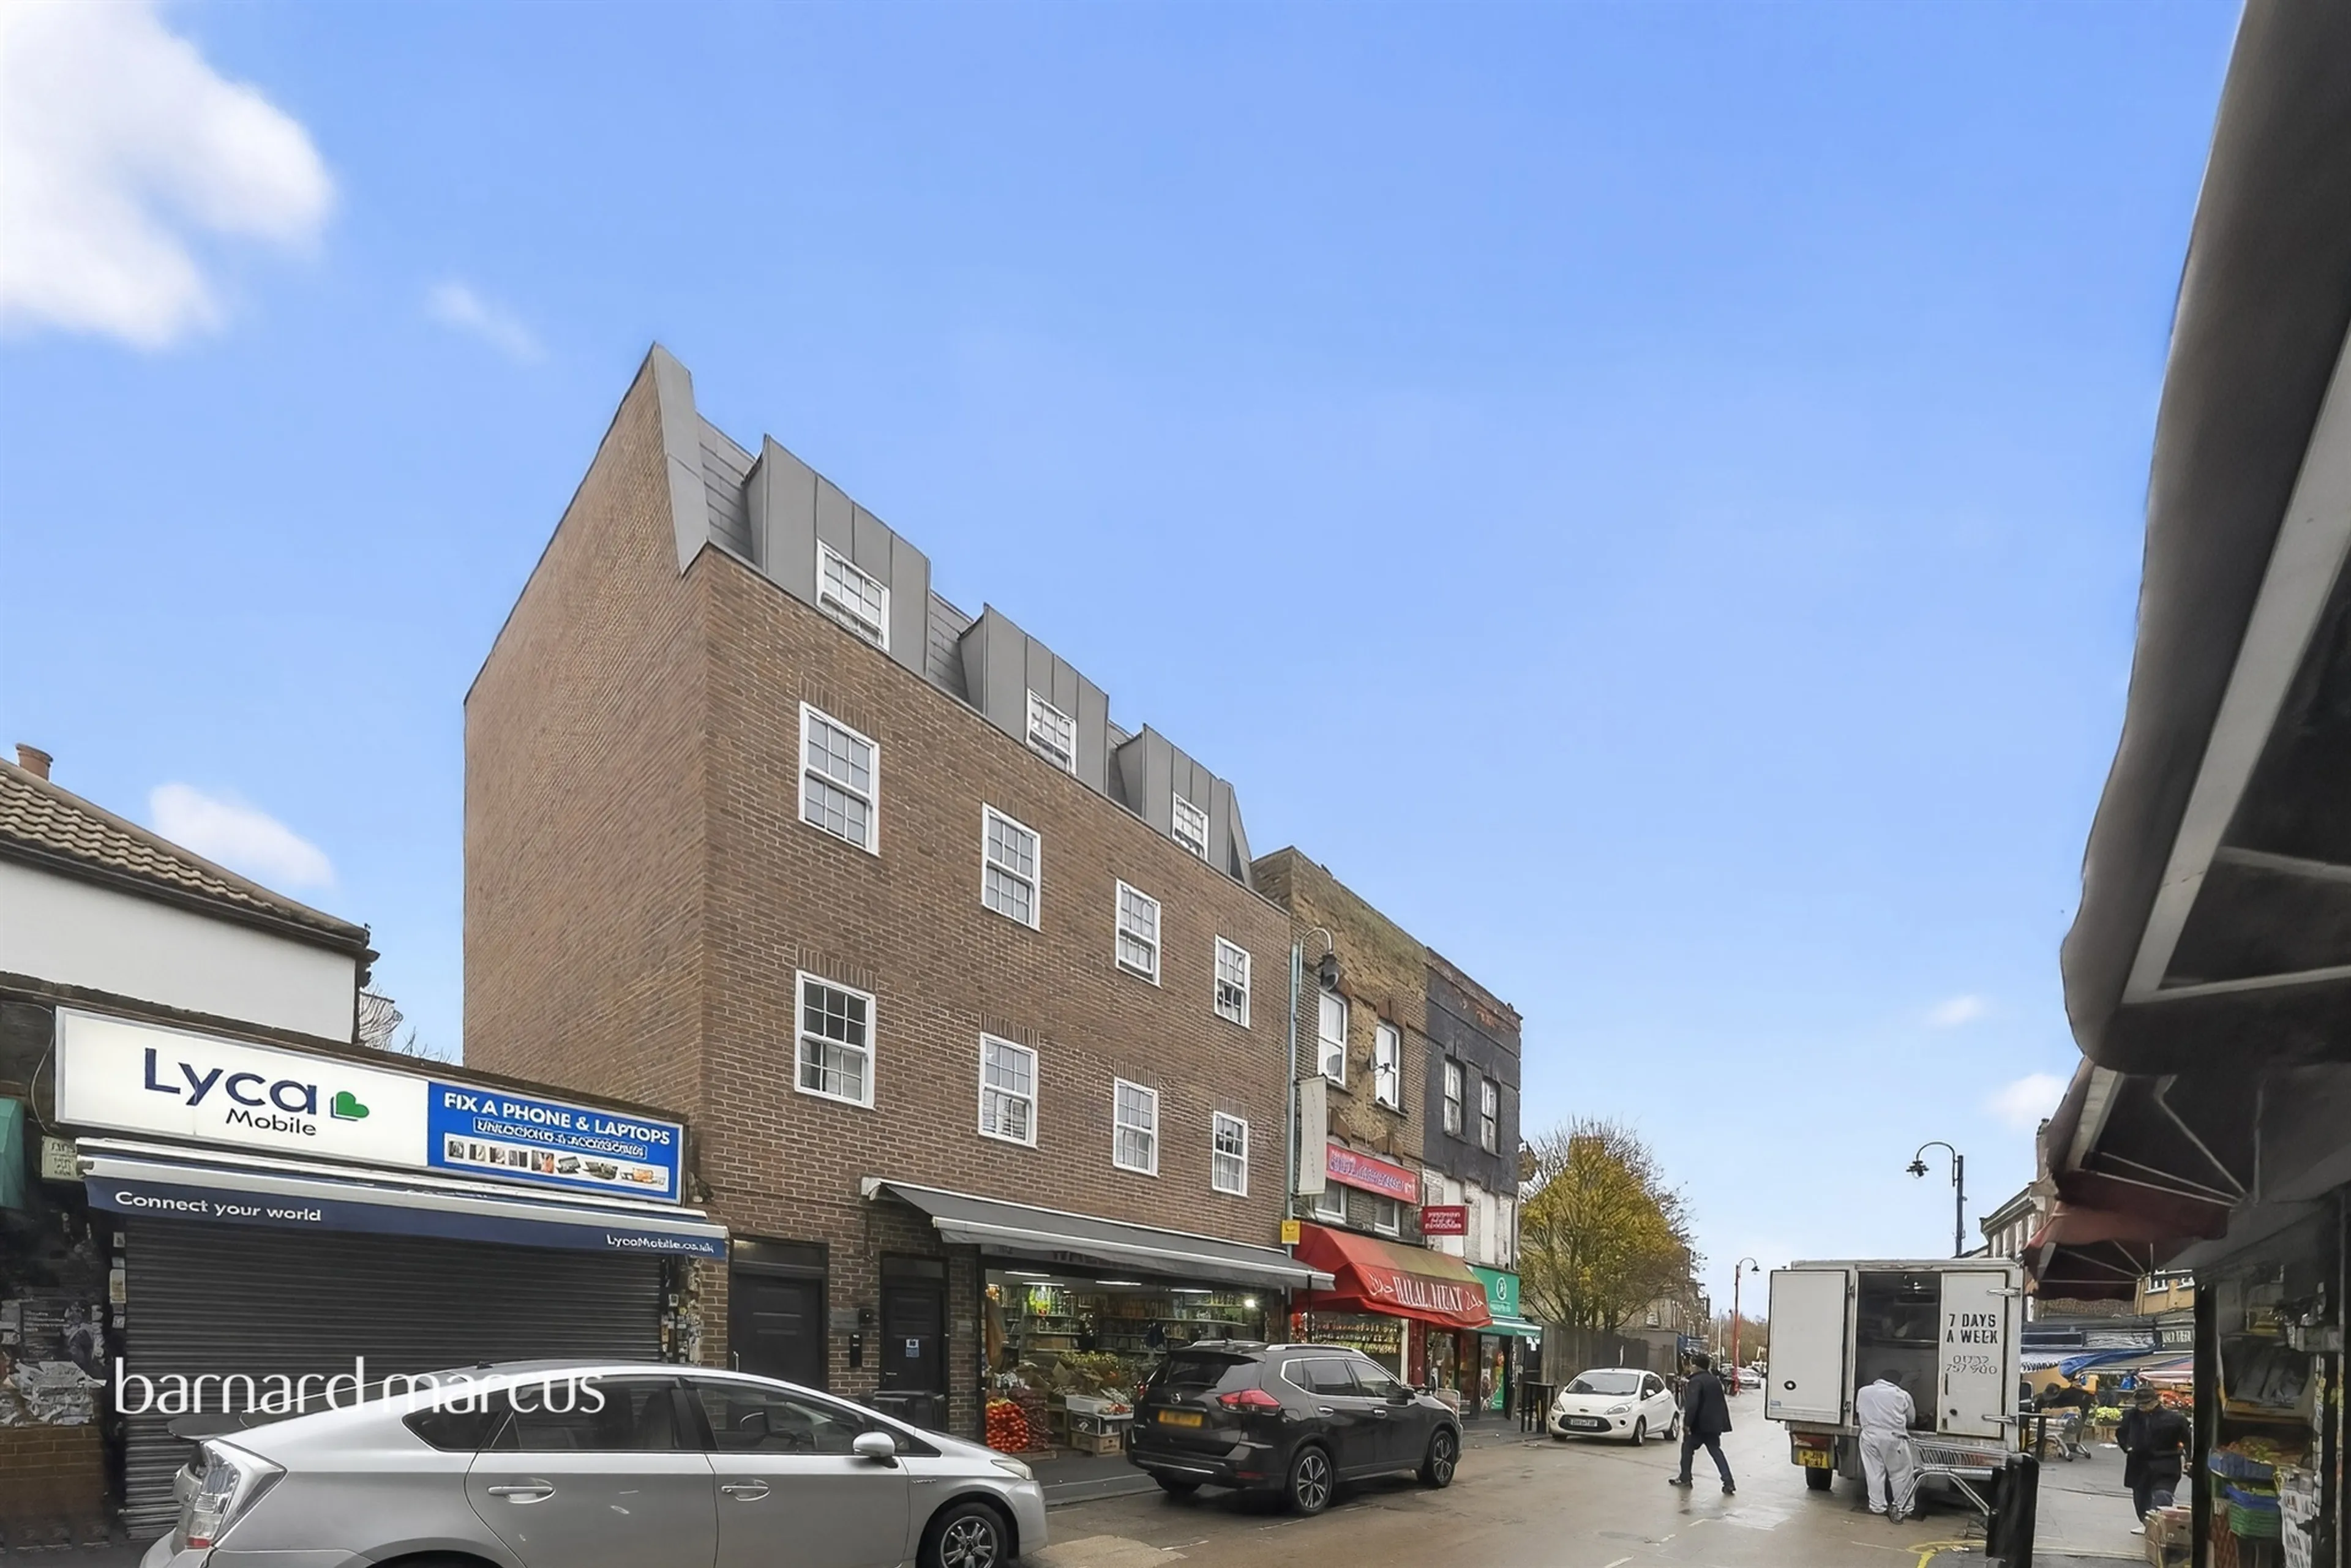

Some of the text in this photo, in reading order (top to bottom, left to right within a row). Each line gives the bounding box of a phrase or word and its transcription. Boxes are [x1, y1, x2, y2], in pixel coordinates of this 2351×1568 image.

[144, 1048, 317, 1116] Lyca
[225, 1108, 317, 1136] Mobile
[444, 1092, 670, 1145] FIX A PHONE & LAPTOPS
[115, 1191, 322, 1222] Connect your world
[1949, 1313, 1996, 1327] 7 DAYS
[1947, 1329, 1998, 1344] A WEEK
